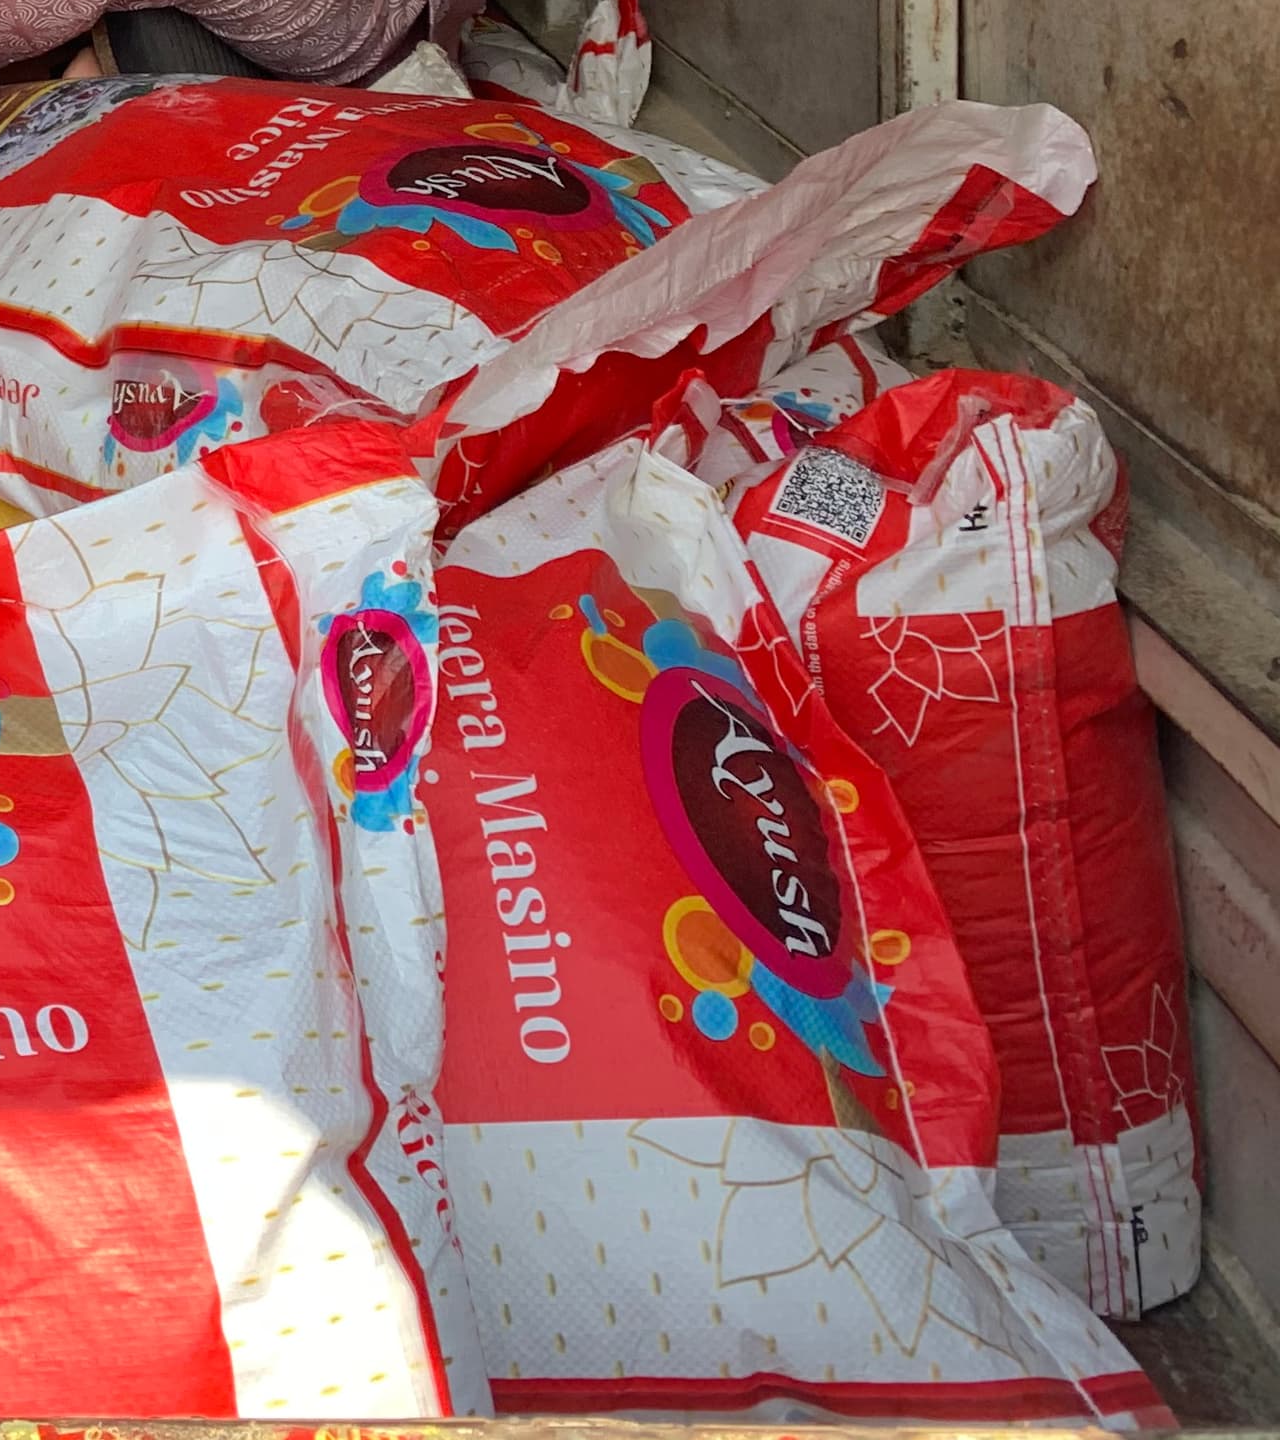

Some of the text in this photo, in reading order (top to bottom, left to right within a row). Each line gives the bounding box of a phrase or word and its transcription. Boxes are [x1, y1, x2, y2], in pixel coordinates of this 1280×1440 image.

[226, 97, 336, 161] Rice
[180, 125, 351, 209] Masino
[395, 154, 567, 200] Ayush
[803, 622, 819, 651] date
[808, 653, 822, 673] the
[349, 620, 388, 772] Ayush
[438, 604, 574, 1066] Jeera Masino
[690, 678, 832, 957] Ayush
